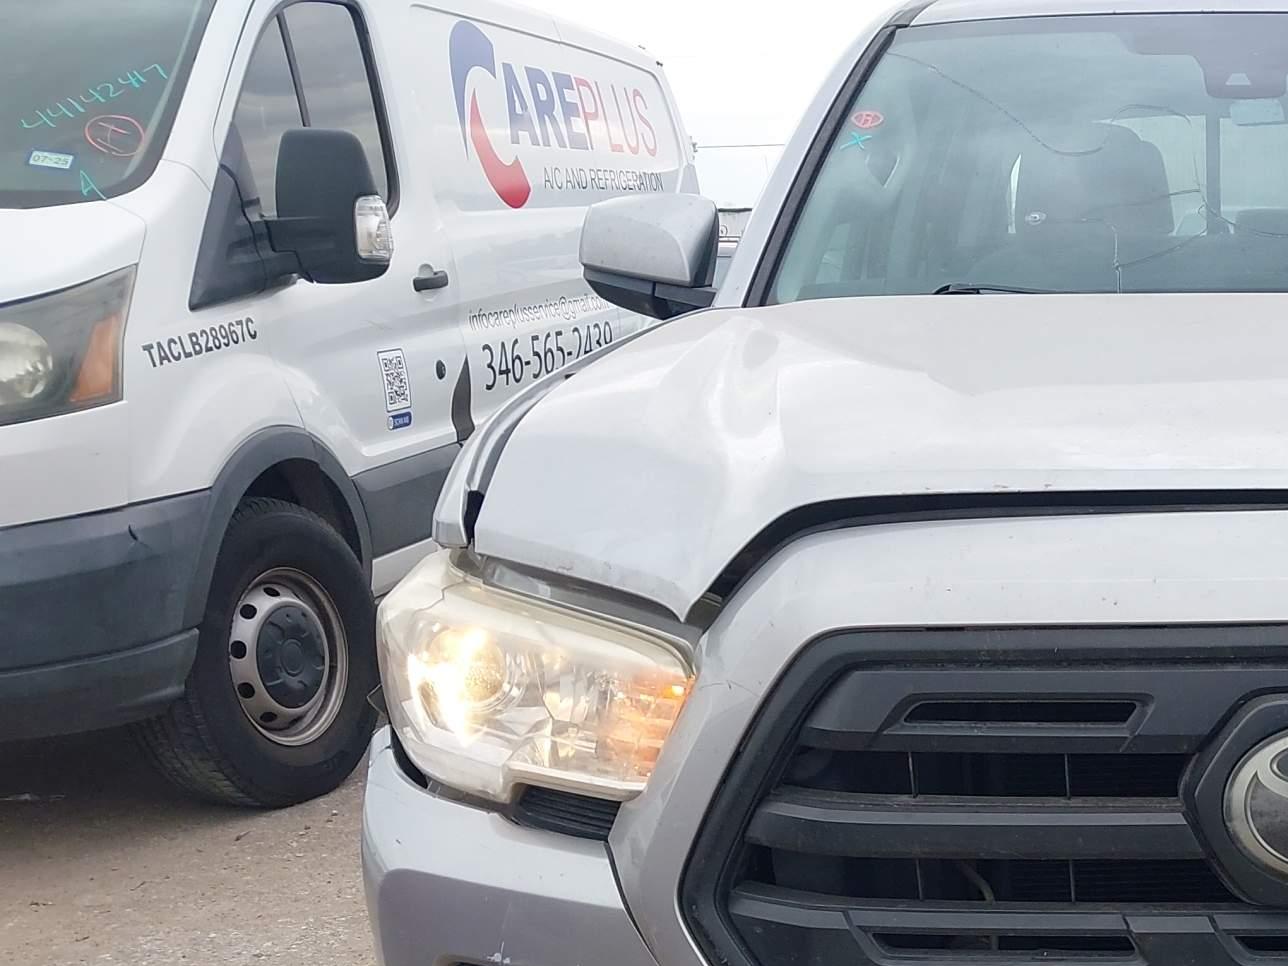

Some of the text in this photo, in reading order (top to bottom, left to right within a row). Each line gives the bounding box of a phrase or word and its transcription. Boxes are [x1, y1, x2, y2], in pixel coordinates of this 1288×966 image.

[19, 63, 168, 129] 44142417
[543, 167, 664, 191] A/C AND REFRIGERATION
[141, 317, 258, 368] TACLB28967C
